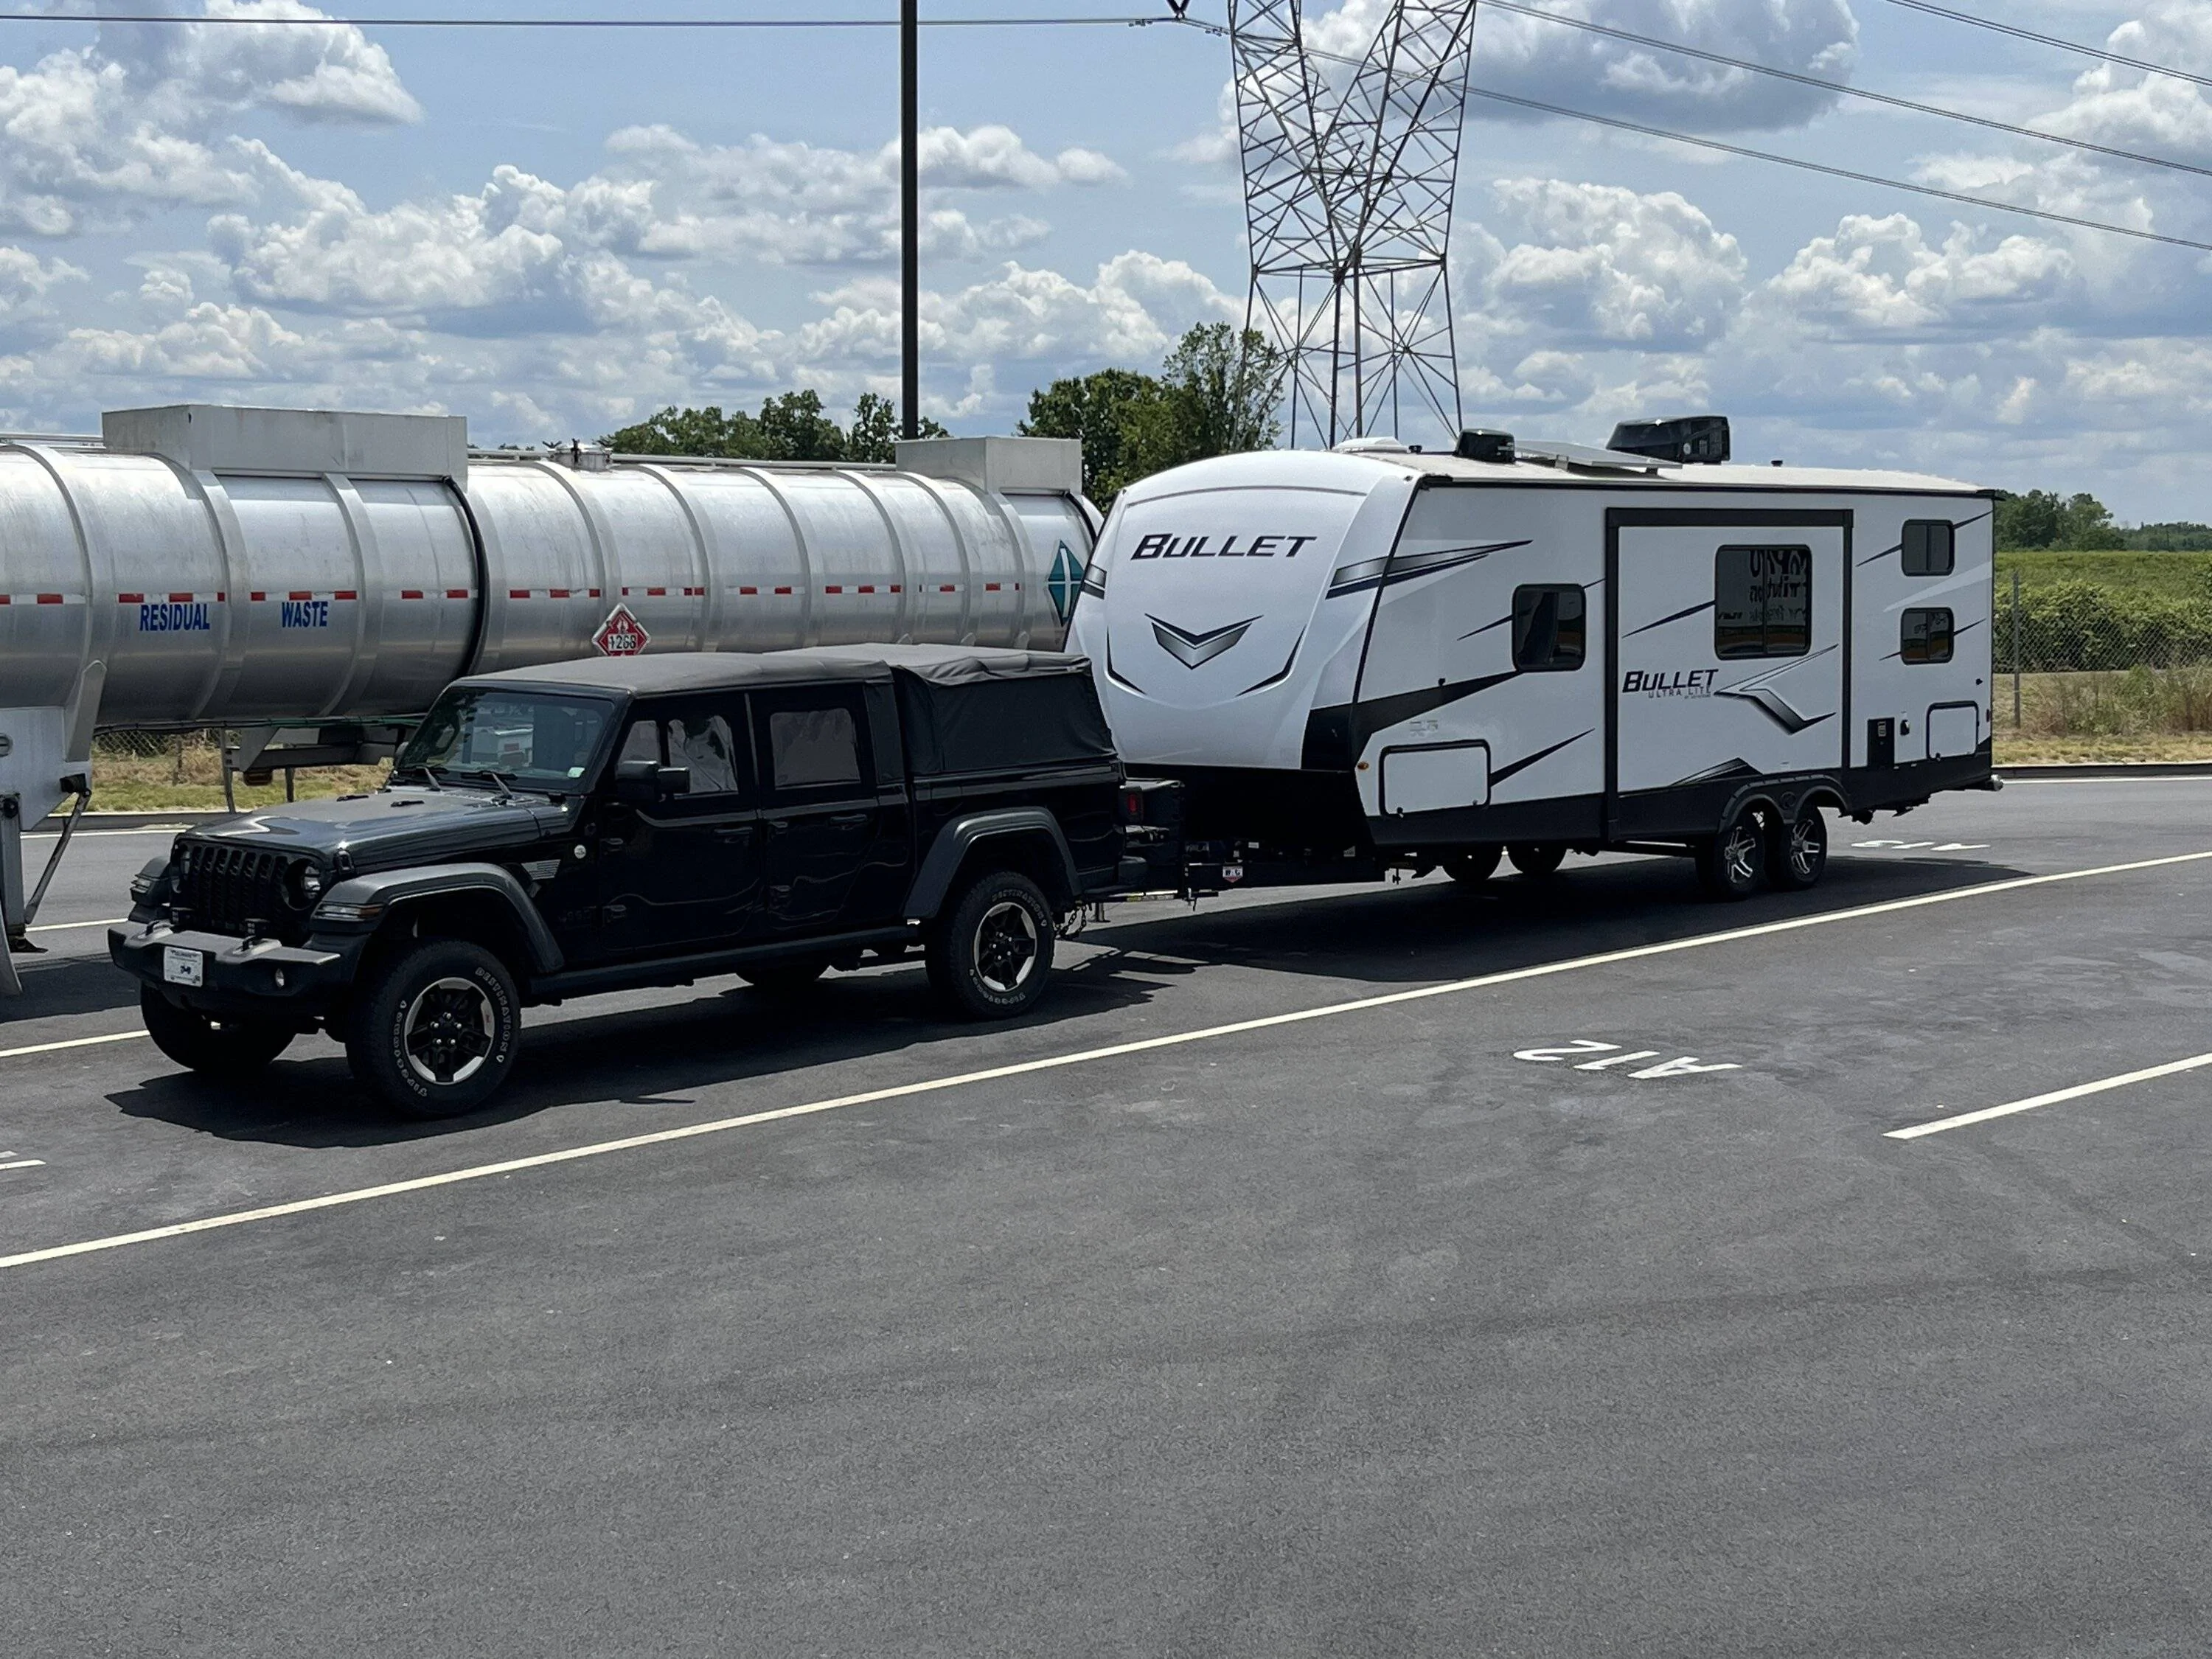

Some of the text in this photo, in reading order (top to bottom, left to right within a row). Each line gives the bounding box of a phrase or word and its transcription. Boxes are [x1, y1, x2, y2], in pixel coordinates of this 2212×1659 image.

[1130, 533, 1318, 560] BULLET
[139, 601, 328, 631] RESIDUAL WASTE
[610, 634, 636, 649] 1268
[1622, 669, 1719, 693] BULLET
[1648, 688, 1682, 699] ULTRA
[1688, 685, 1711, 695] LITE
[1513, 1040, 1743, 1079] A12
